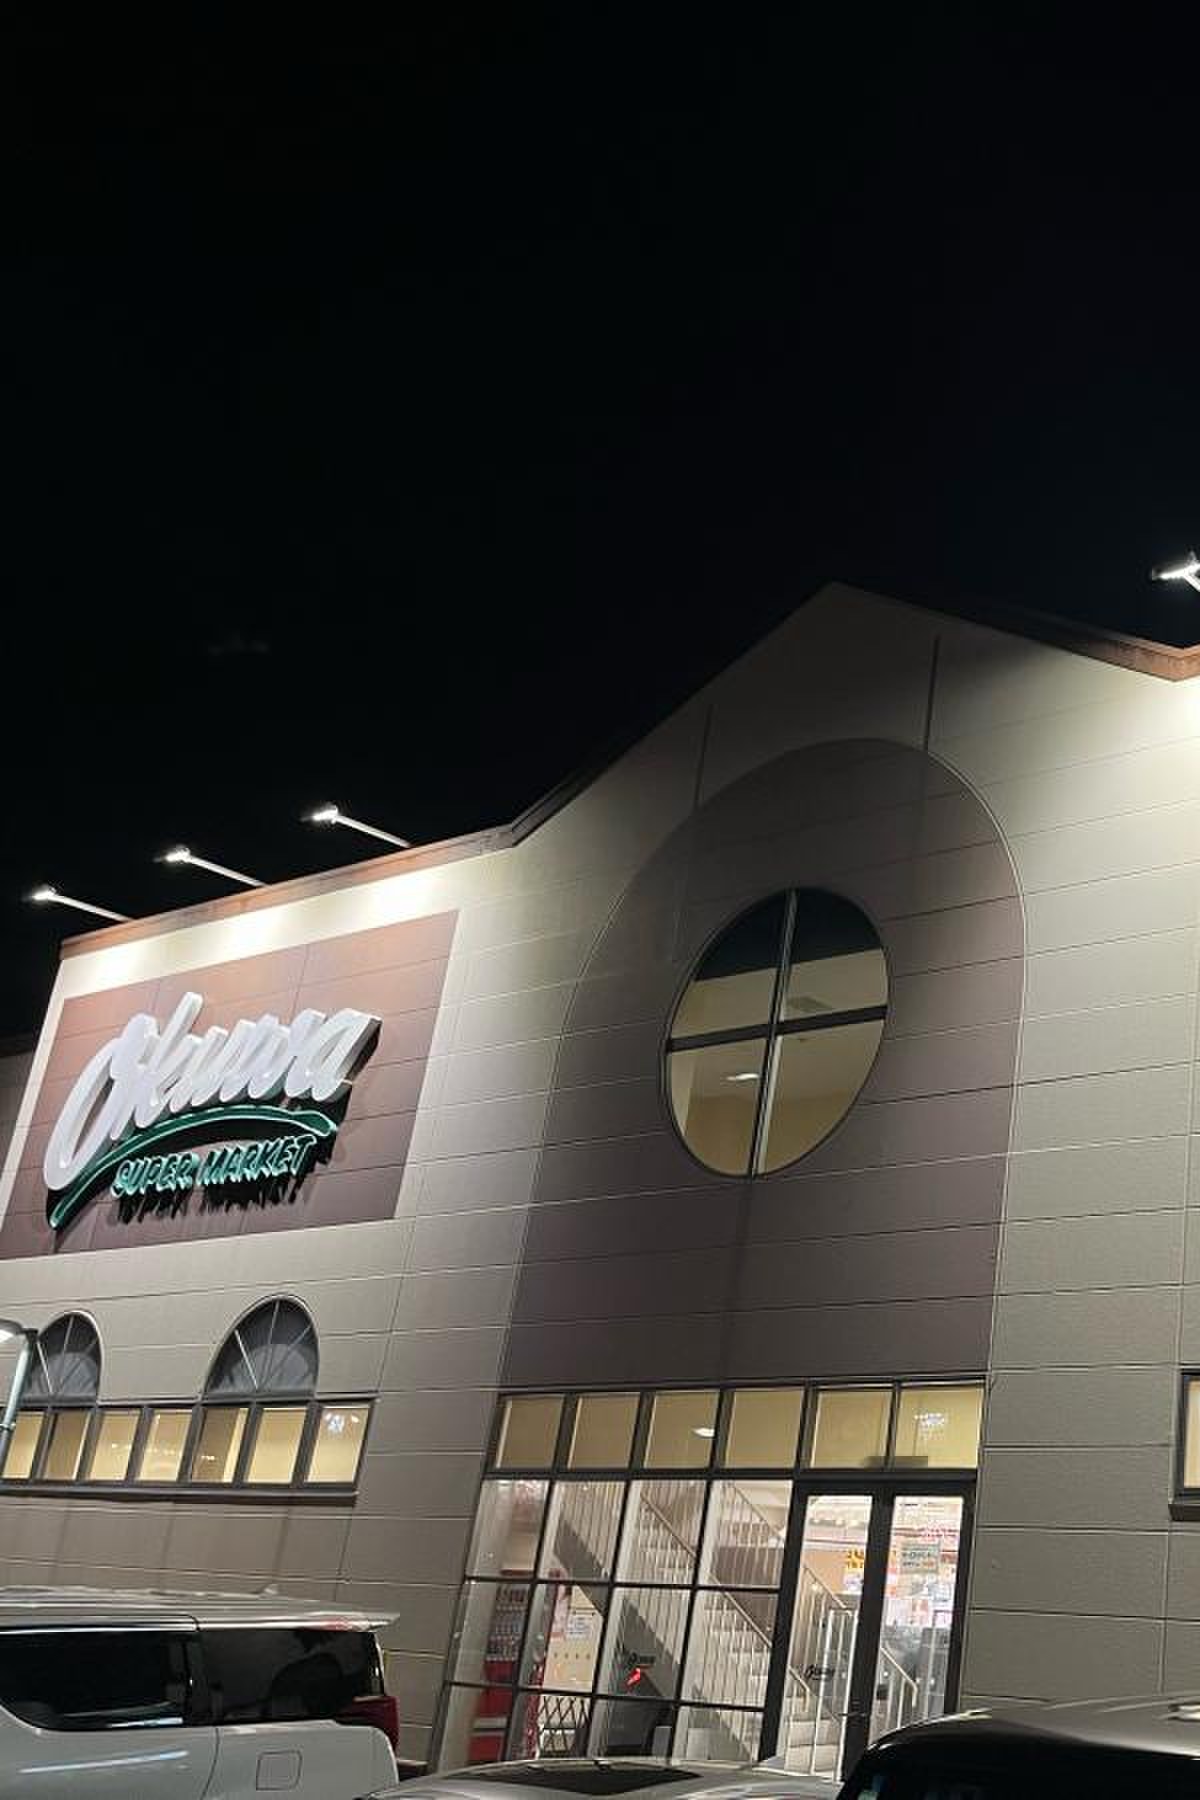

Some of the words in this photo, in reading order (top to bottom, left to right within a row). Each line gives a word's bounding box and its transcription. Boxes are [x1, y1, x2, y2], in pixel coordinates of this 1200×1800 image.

[43, 991, 382, 1190] Okuwa
[110, 1151, 199, 1198] SUPER
[196, 1134, 317, 1186] MARKET
